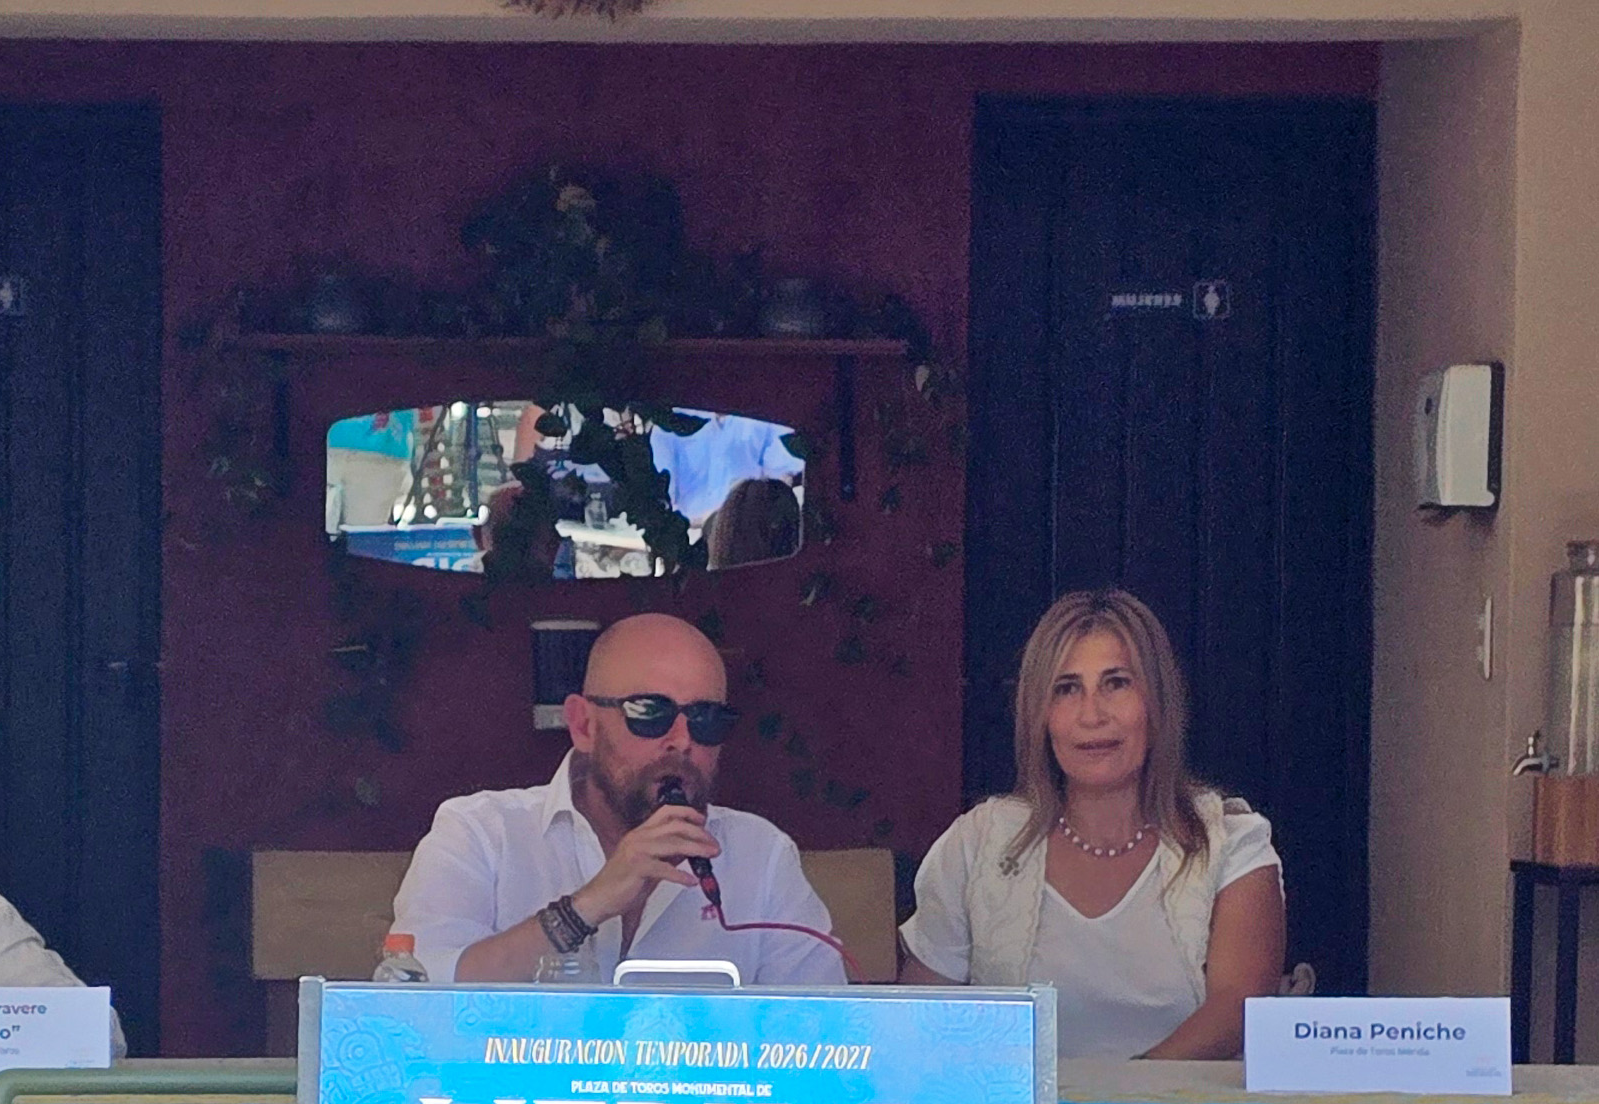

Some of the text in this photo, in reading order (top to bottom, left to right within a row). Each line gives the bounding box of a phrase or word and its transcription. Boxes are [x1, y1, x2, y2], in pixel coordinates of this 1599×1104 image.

[1294, 1021, 1466, 1041] Diana Peniche
[484, 1037, 872, 1070] INAUGURACION TEMPORADA 2026/2027
[570, 1080, 610, 1094] PLAZA
[611, 1081, 628, 1095] DE
[630, 1081, 670, 1095] TOROS
[756, 1084, 773, 1097] DE
